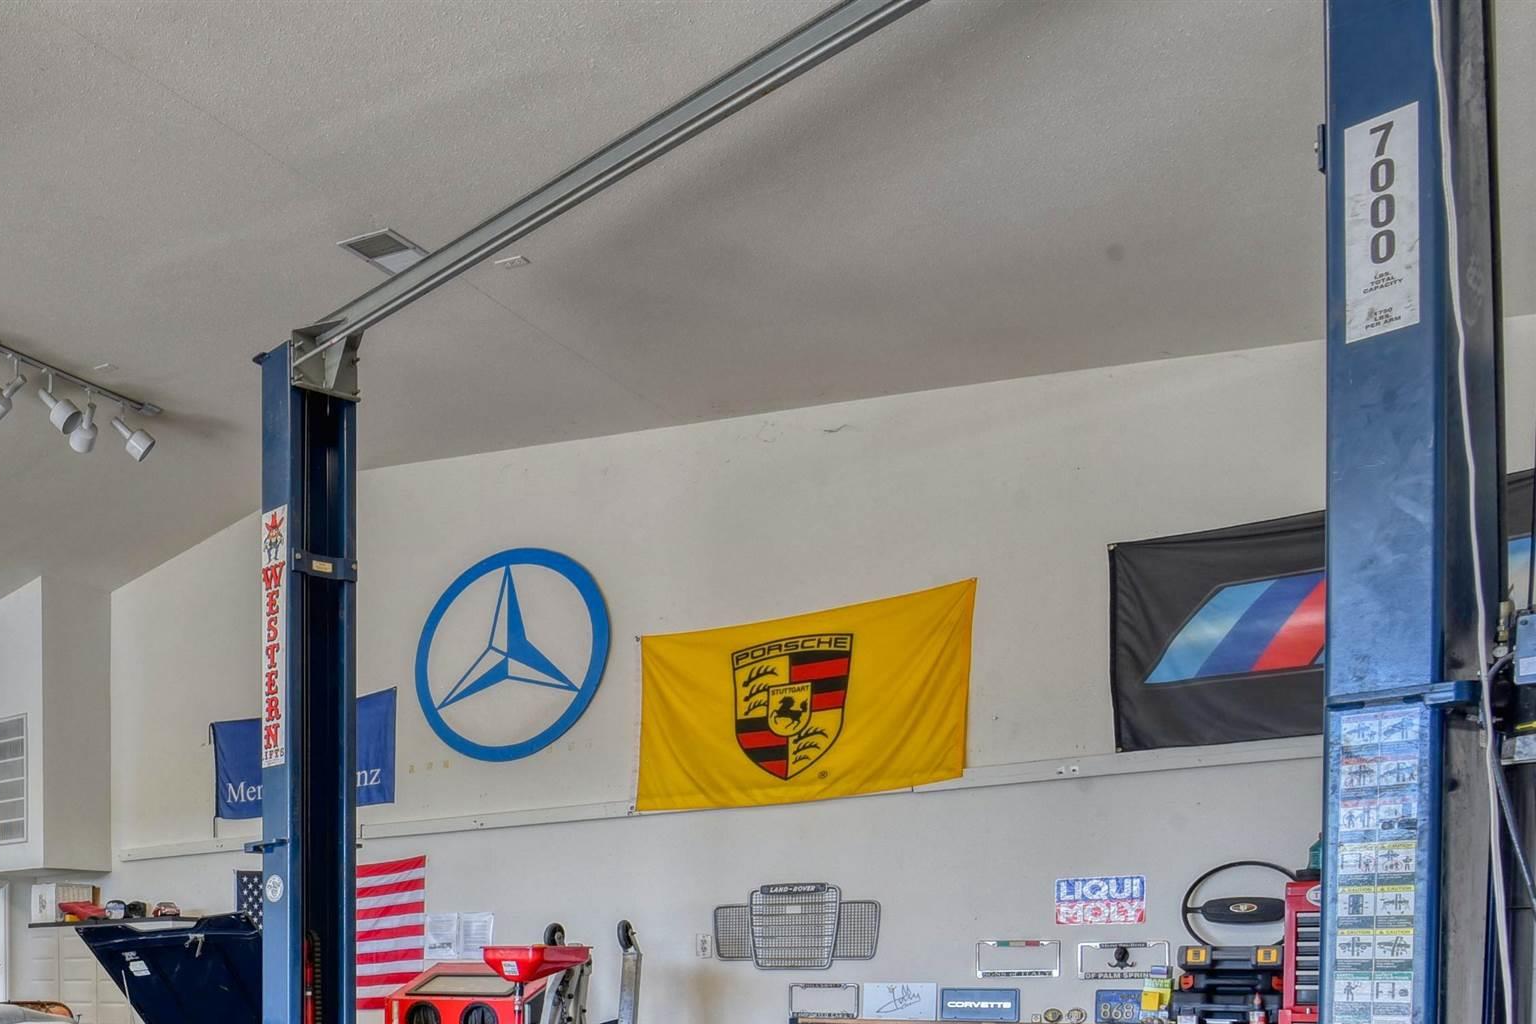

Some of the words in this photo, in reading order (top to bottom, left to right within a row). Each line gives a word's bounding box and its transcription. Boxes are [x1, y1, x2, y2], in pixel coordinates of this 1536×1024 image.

[1369, 120, 1396, 265] 7000
[1363, 278, 1404, 294] CAPACITY
[1370, 275, 1395, 287] TOTAL
[261, 561, 286, 750] WESTERN
[735, 637, 849, 666] PORSCHE
[771, 685, 811, 696] STUTTGART
[1059, 878, 1141, 901] LIQUI
[1058, 901, 1139, 923] MOLY
[946, 1001, 1012, 1009] CORVETTE
